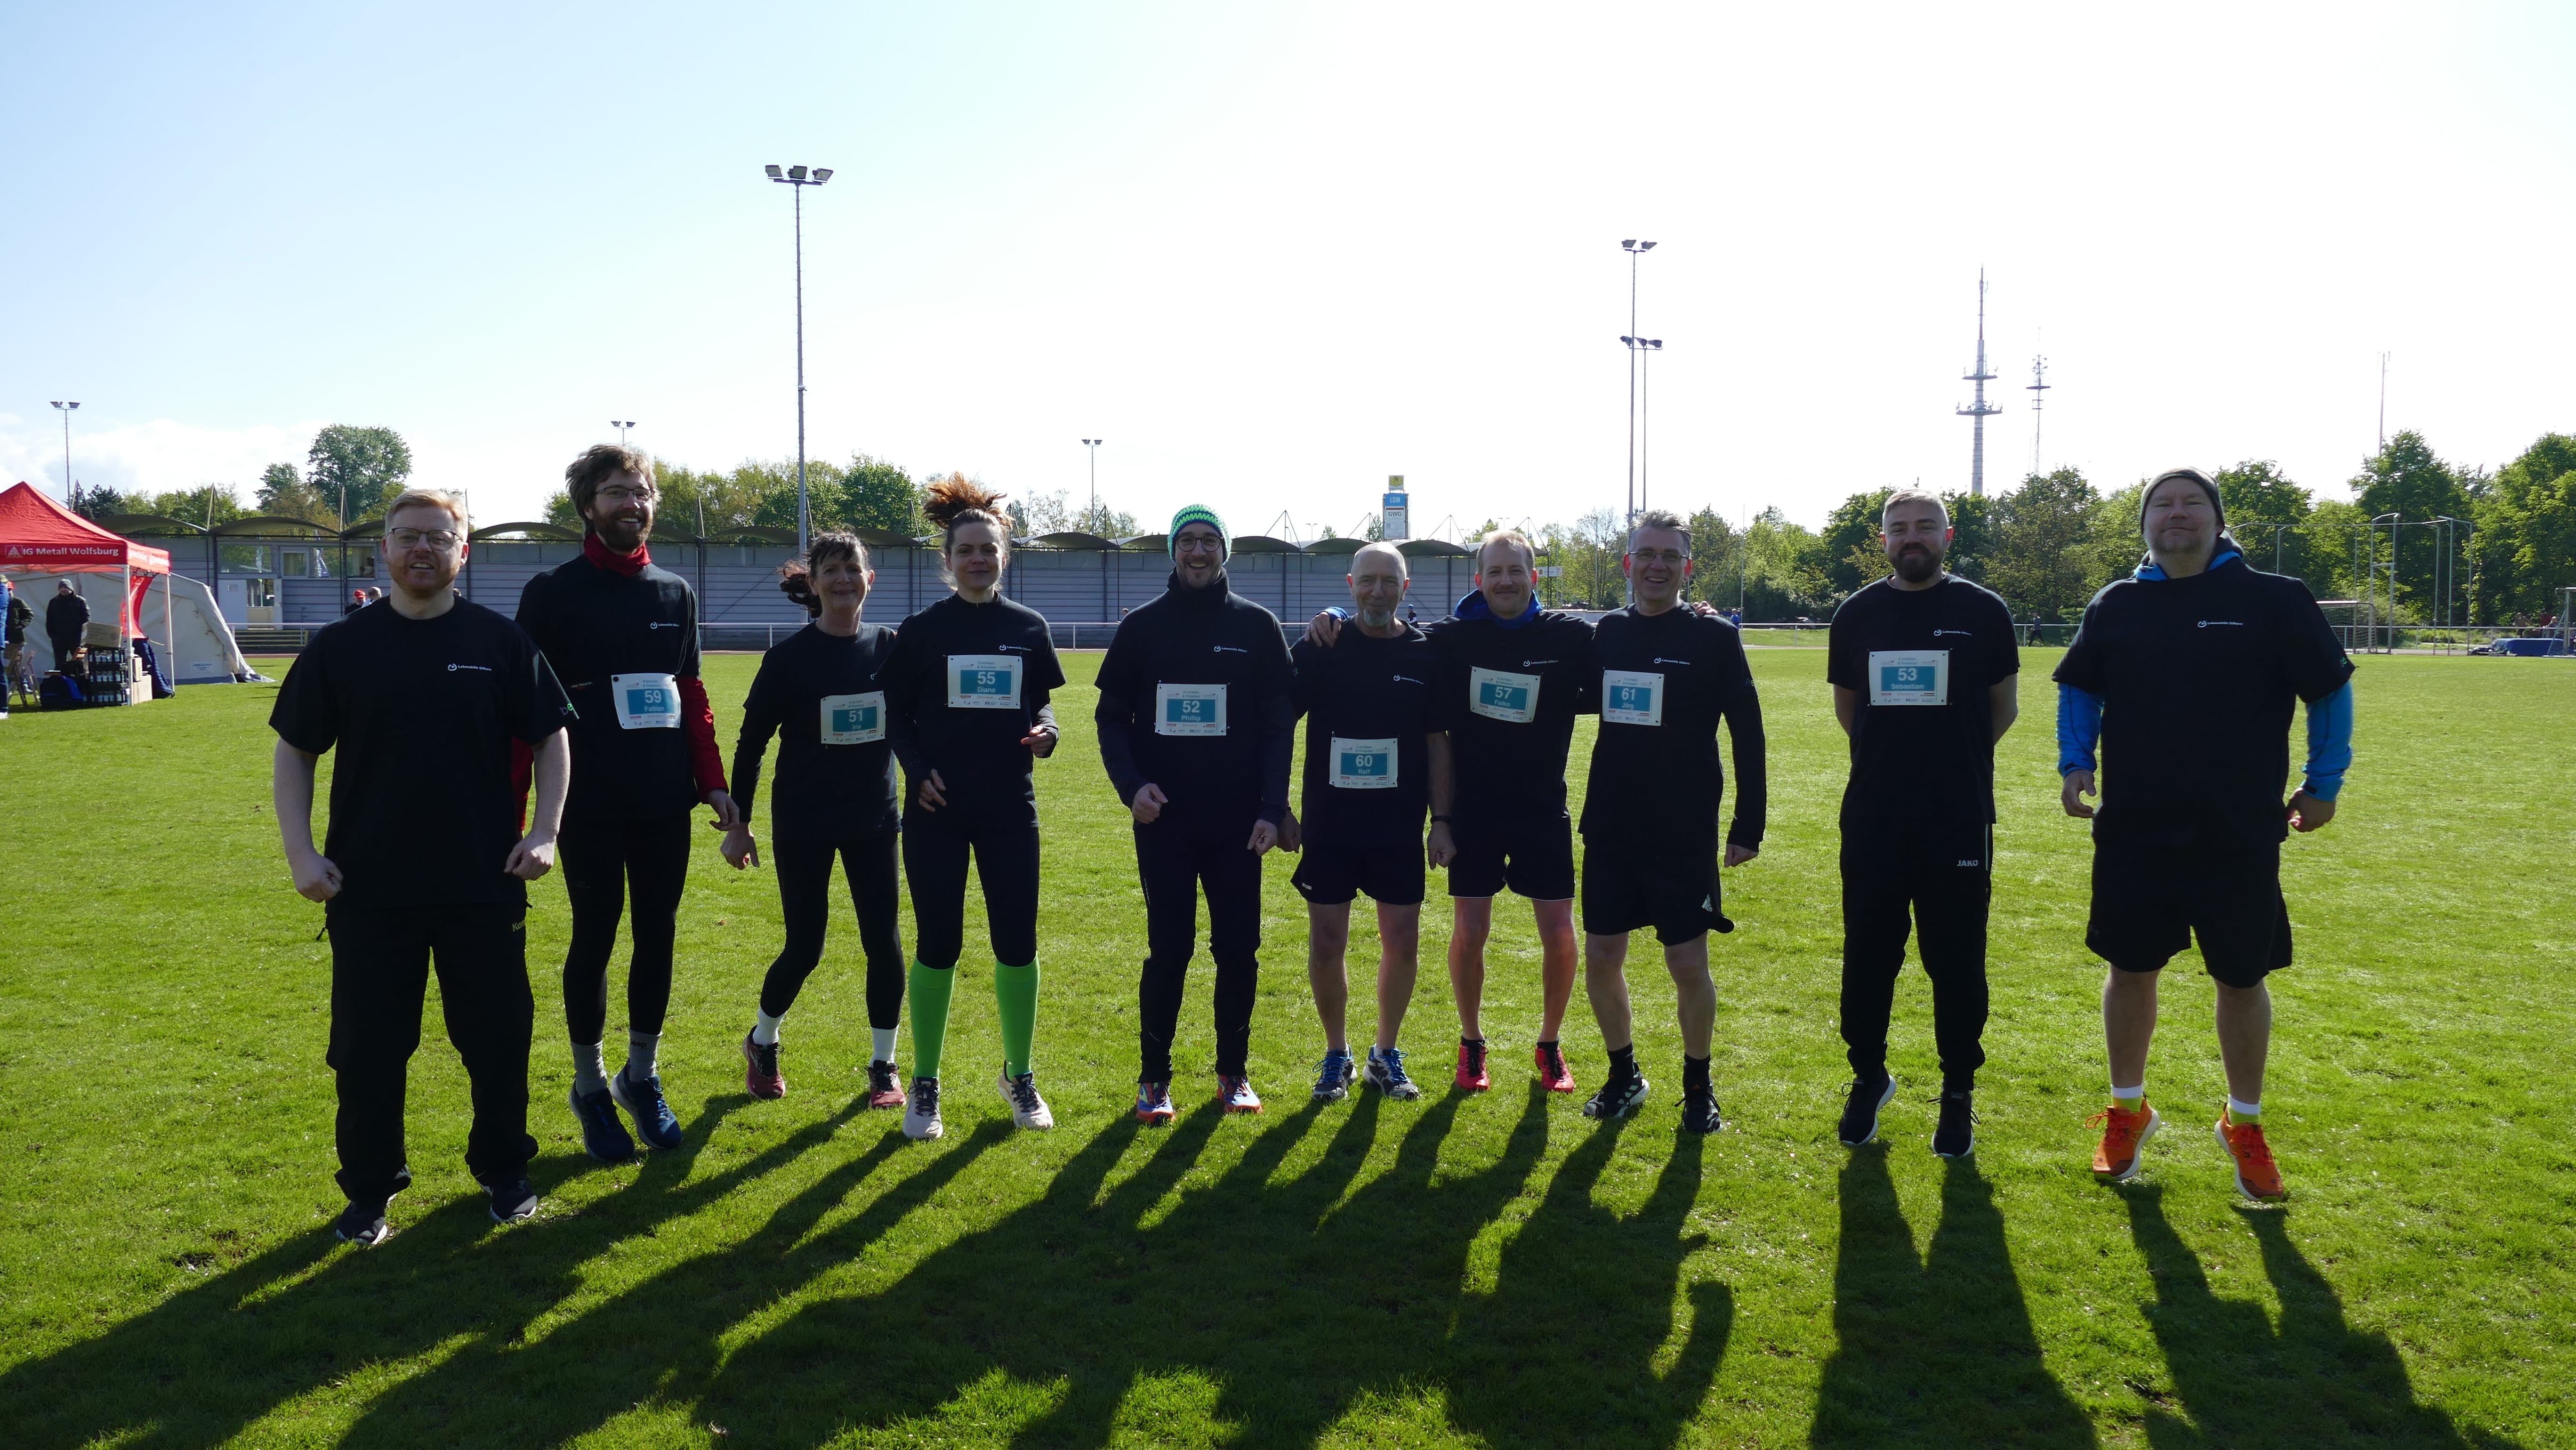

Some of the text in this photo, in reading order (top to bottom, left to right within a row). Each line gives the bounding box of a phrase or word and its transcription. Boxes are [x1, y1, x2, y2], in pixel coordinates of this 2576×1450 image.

[70, 548, 119, 556] Wolfsburg
[977, 672, 995, 685] 55
[1898, 668, 1917, 681] 53
[644, 690, 662, 703] 59
[1495, 686, 1513, 699] 57
[1621, 687, 1635, 701] 61
[1182, 701, 1200, 713] 52
[849, 709, 863, 723] 51
[1356, 755, 1373, 767] 60
